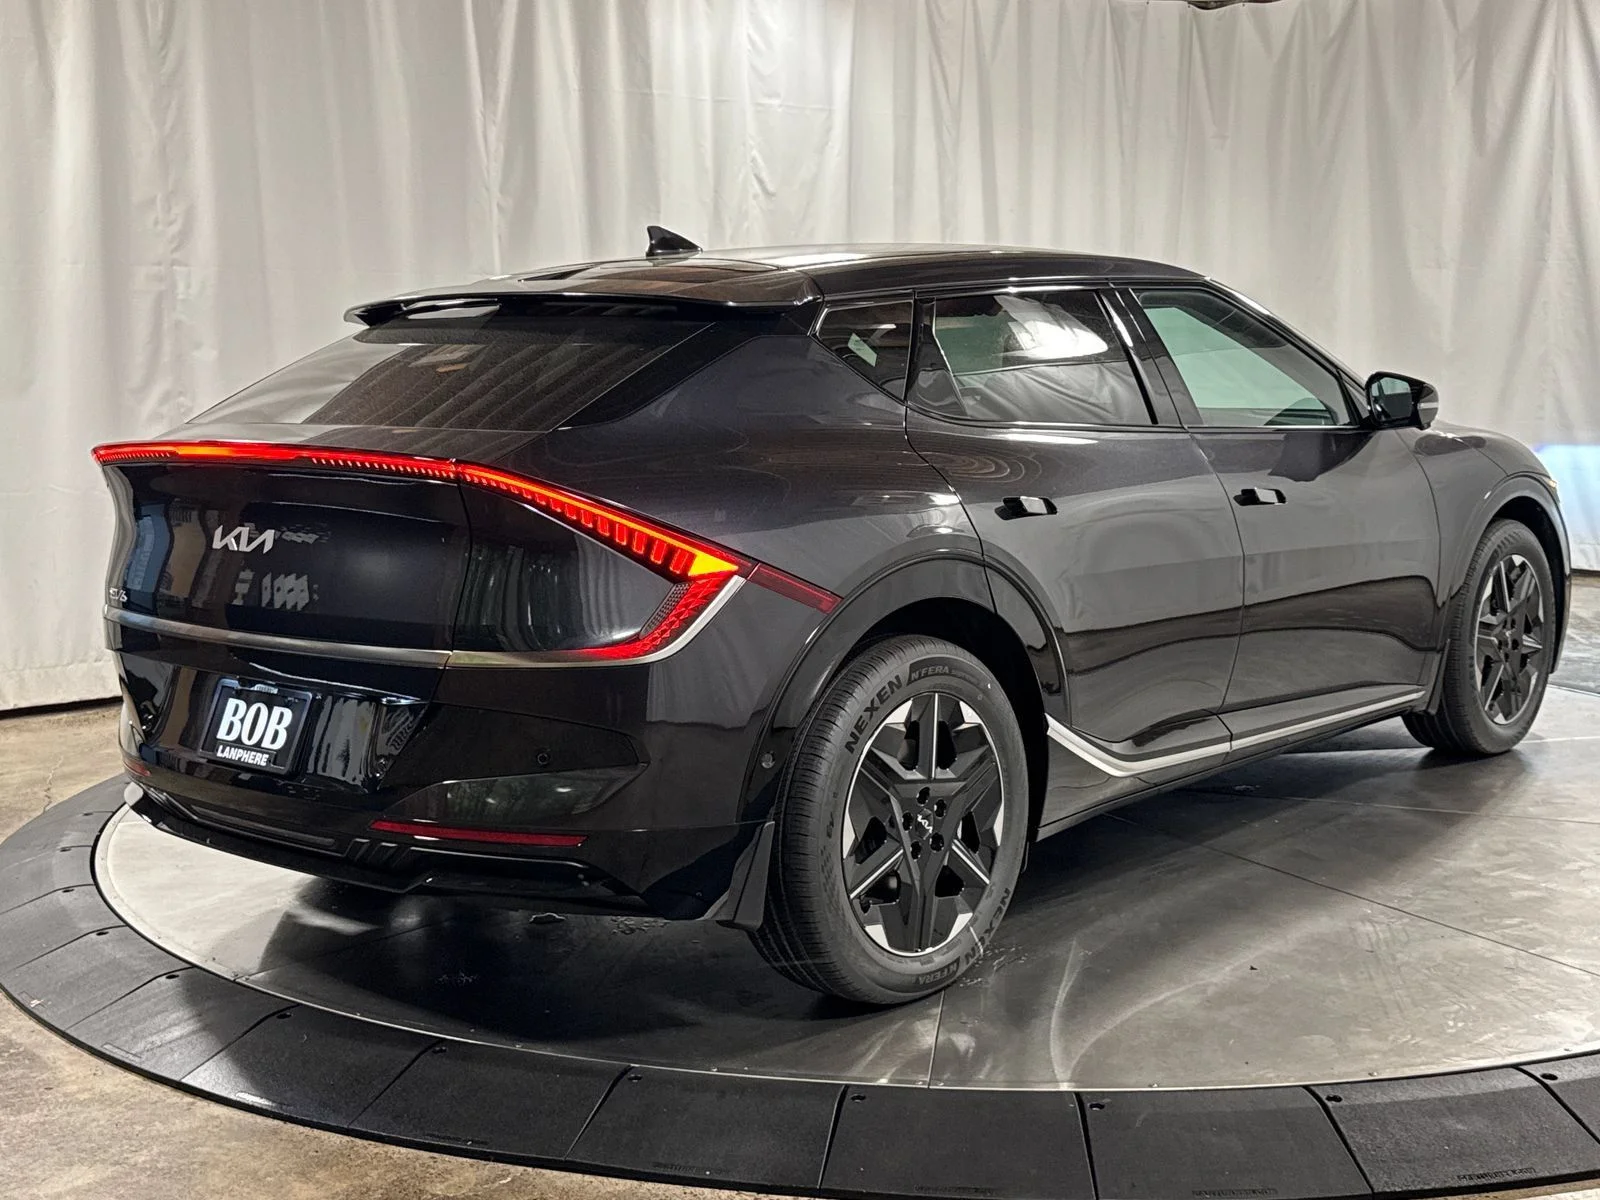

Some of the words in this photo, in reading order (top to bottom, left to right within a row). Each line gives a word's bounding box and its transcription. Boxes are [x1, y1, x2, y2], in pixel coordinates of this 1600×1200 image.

[212, 525, 275, 554] KIA
[216, 698, 293, 750] BOB
[845, 674, 903, 754] NEXEN
[216, 745, 270, 767] LANPHERE
